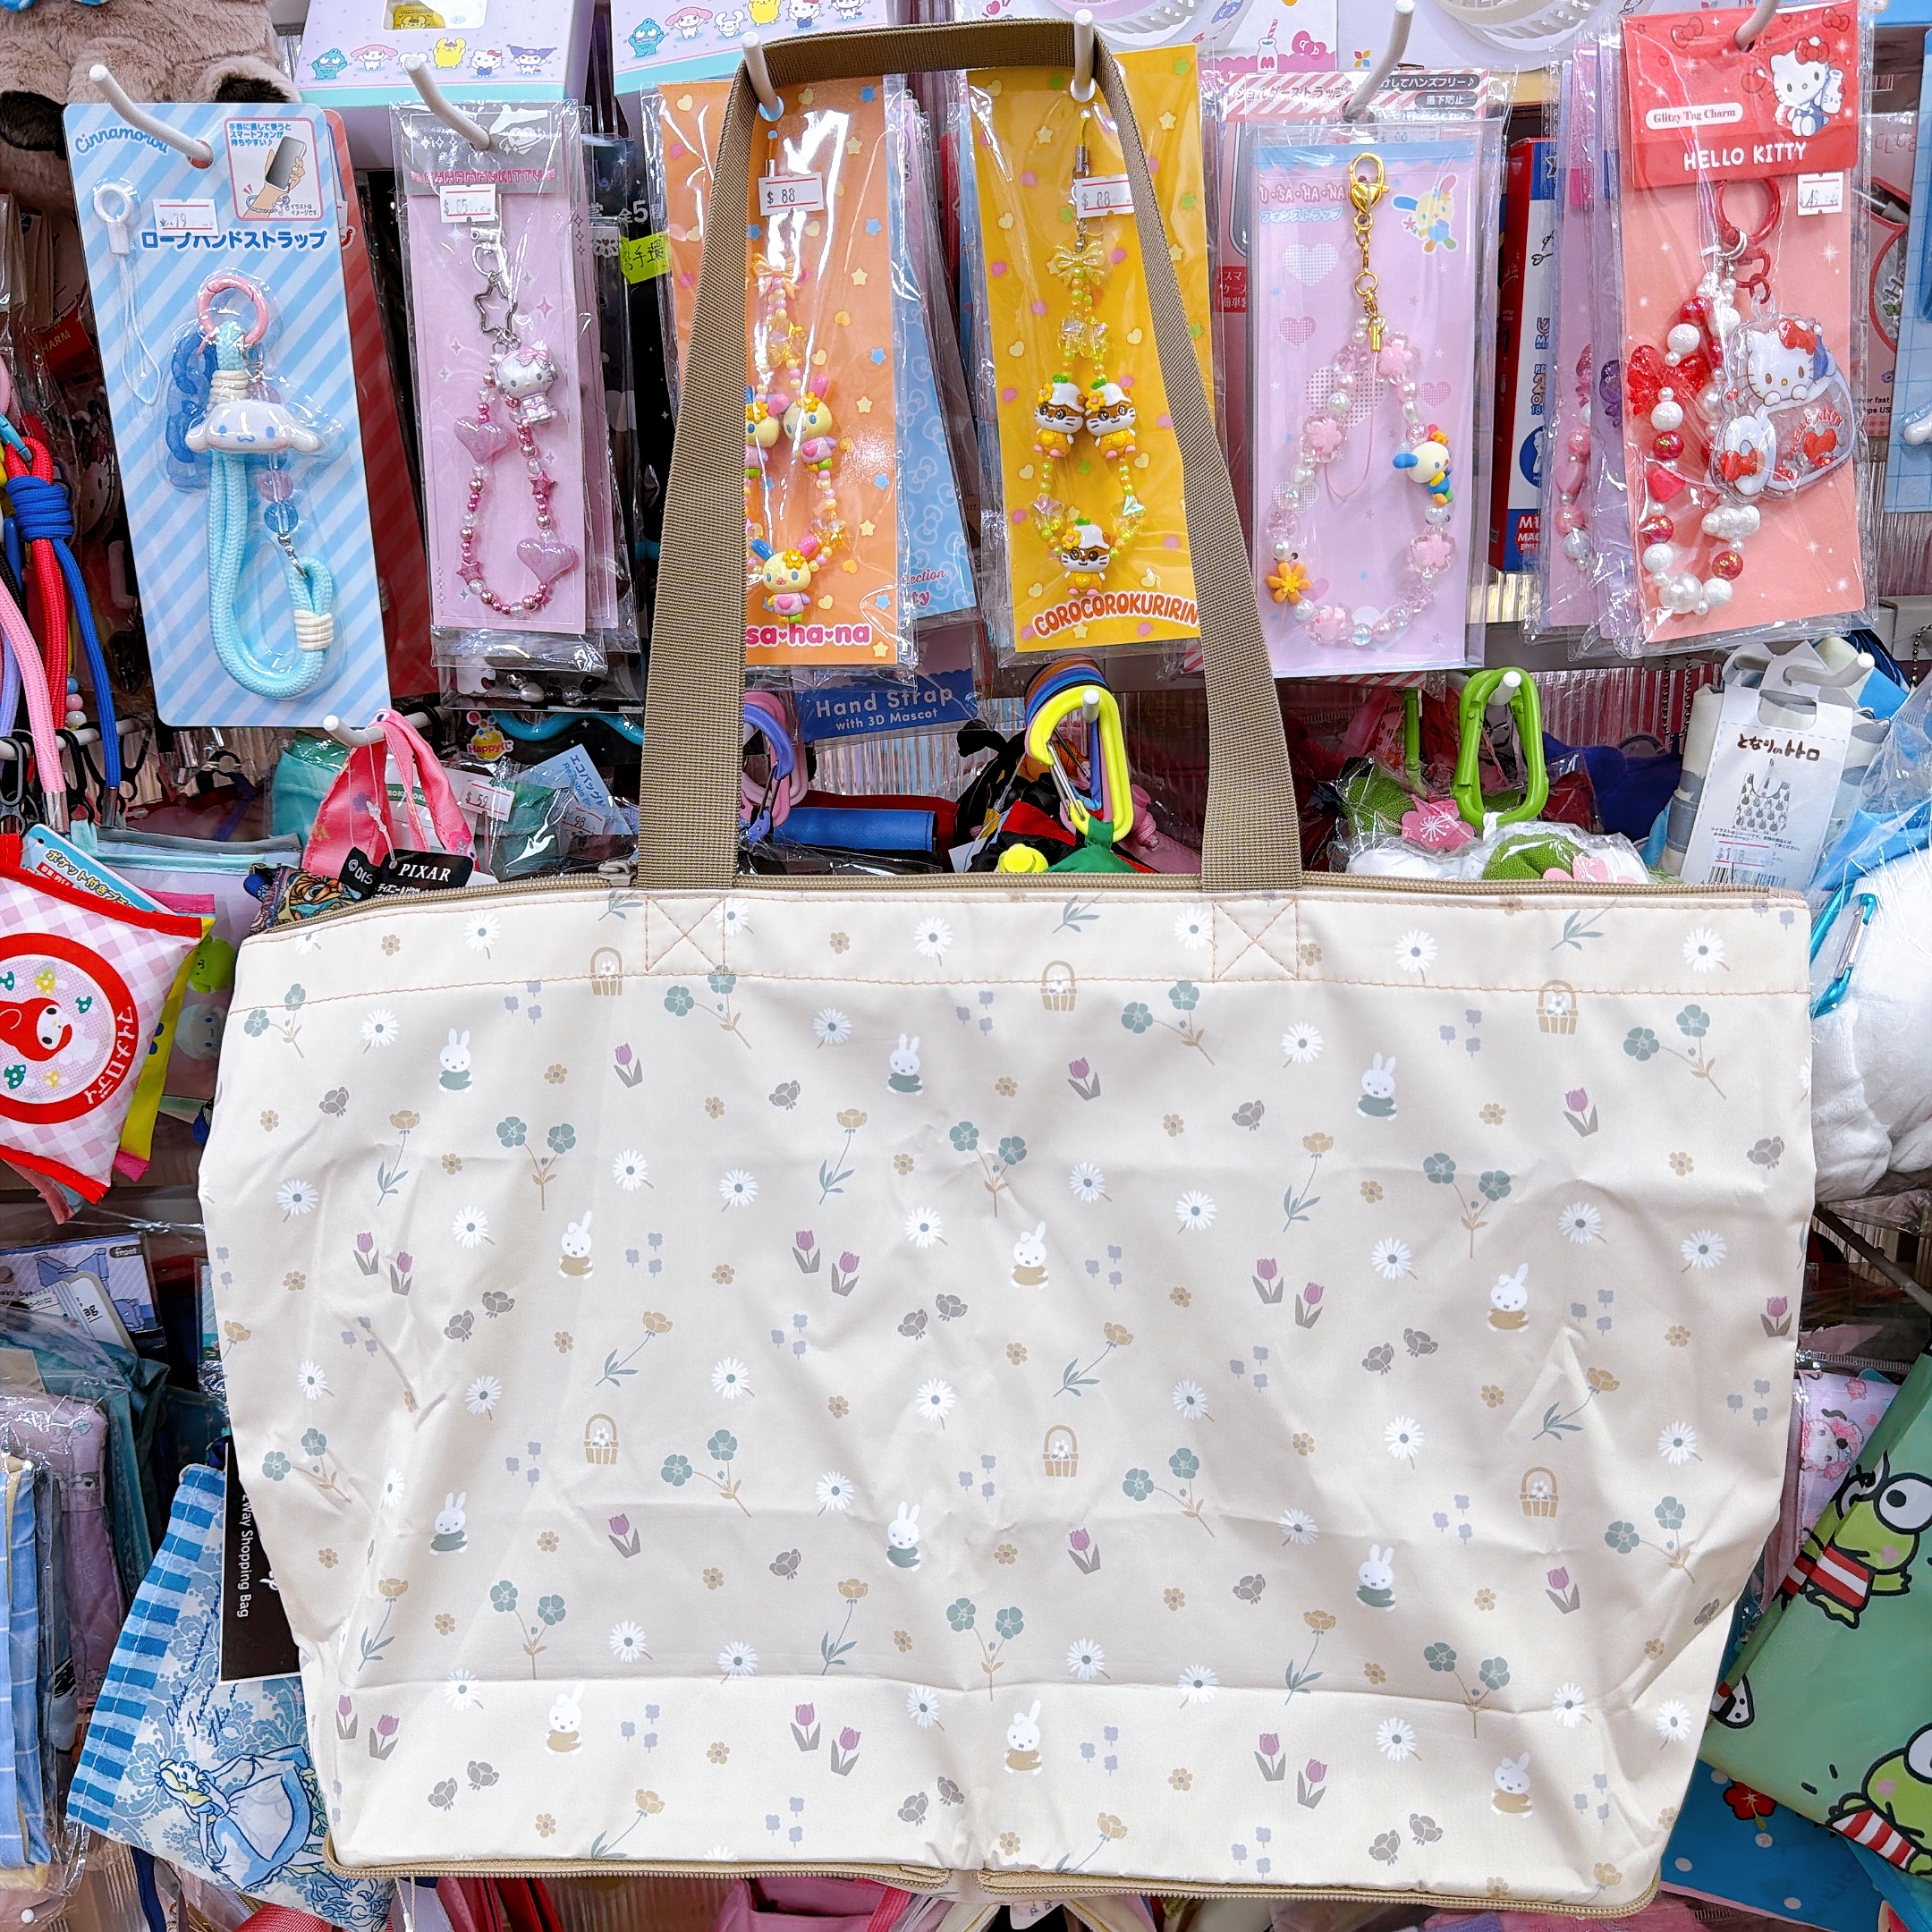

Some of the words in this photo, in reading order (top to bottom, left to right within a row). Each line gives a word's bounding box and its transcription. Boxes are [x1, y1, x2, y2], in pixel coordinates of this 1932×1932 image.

[1703, 107, 1736, 119] Charm
[1682, 147, 1745, 172] HELLO
[1753, 141, 1808, 165] KITTY
[781, 187, 796, 205] 88
[816, 693, 878, 718] Hand
[887, 687, 953, 708] Strap
[835, 716, 864, 732] with
[868, 714, 886, 727] 3D
[889, 707, 938, 724] Mascot
[1737, 733, 1821, 761] となりのトトロ
[477, 794, 488, 809] 59
[574, 815, 587, 829] 98
[397, 863, 452, 883] PIXAR
[83, 1005, 136, 1105] マイメロディ
[237, 1530, 255, 1590] Shopping
[236, 1592, 253, 1619] Bag
